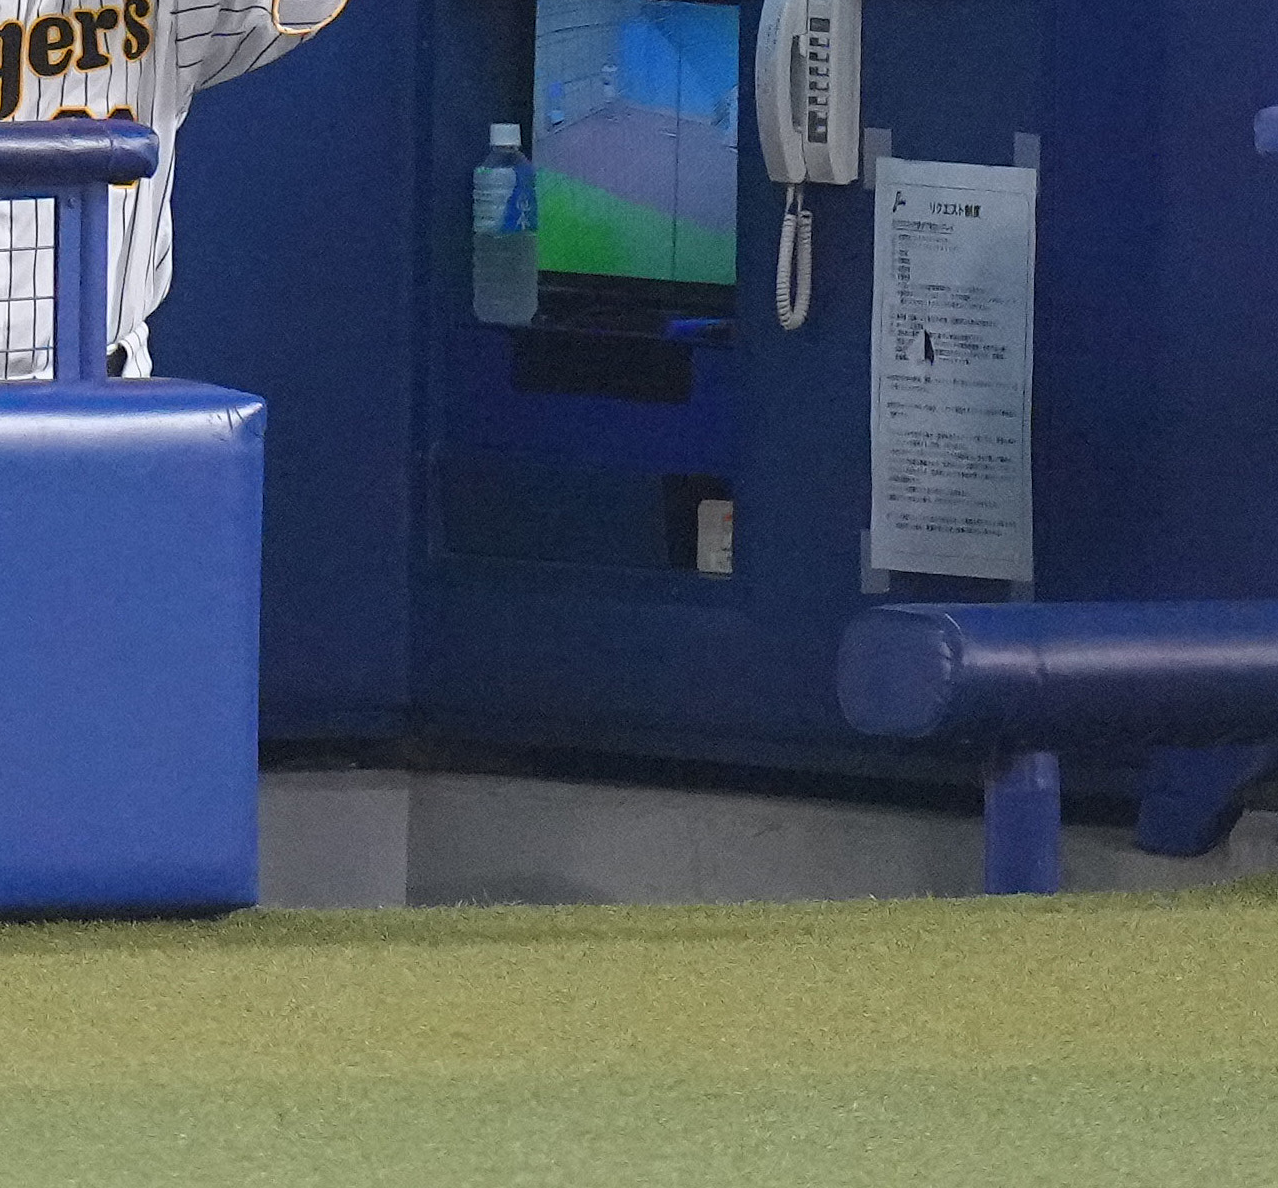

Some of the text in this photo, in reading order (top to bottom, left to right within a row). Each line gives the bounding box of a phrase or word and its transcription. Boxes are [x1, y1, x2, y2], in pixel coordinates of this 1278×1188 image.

[929, 201, 982, 218] リクエスト制度
